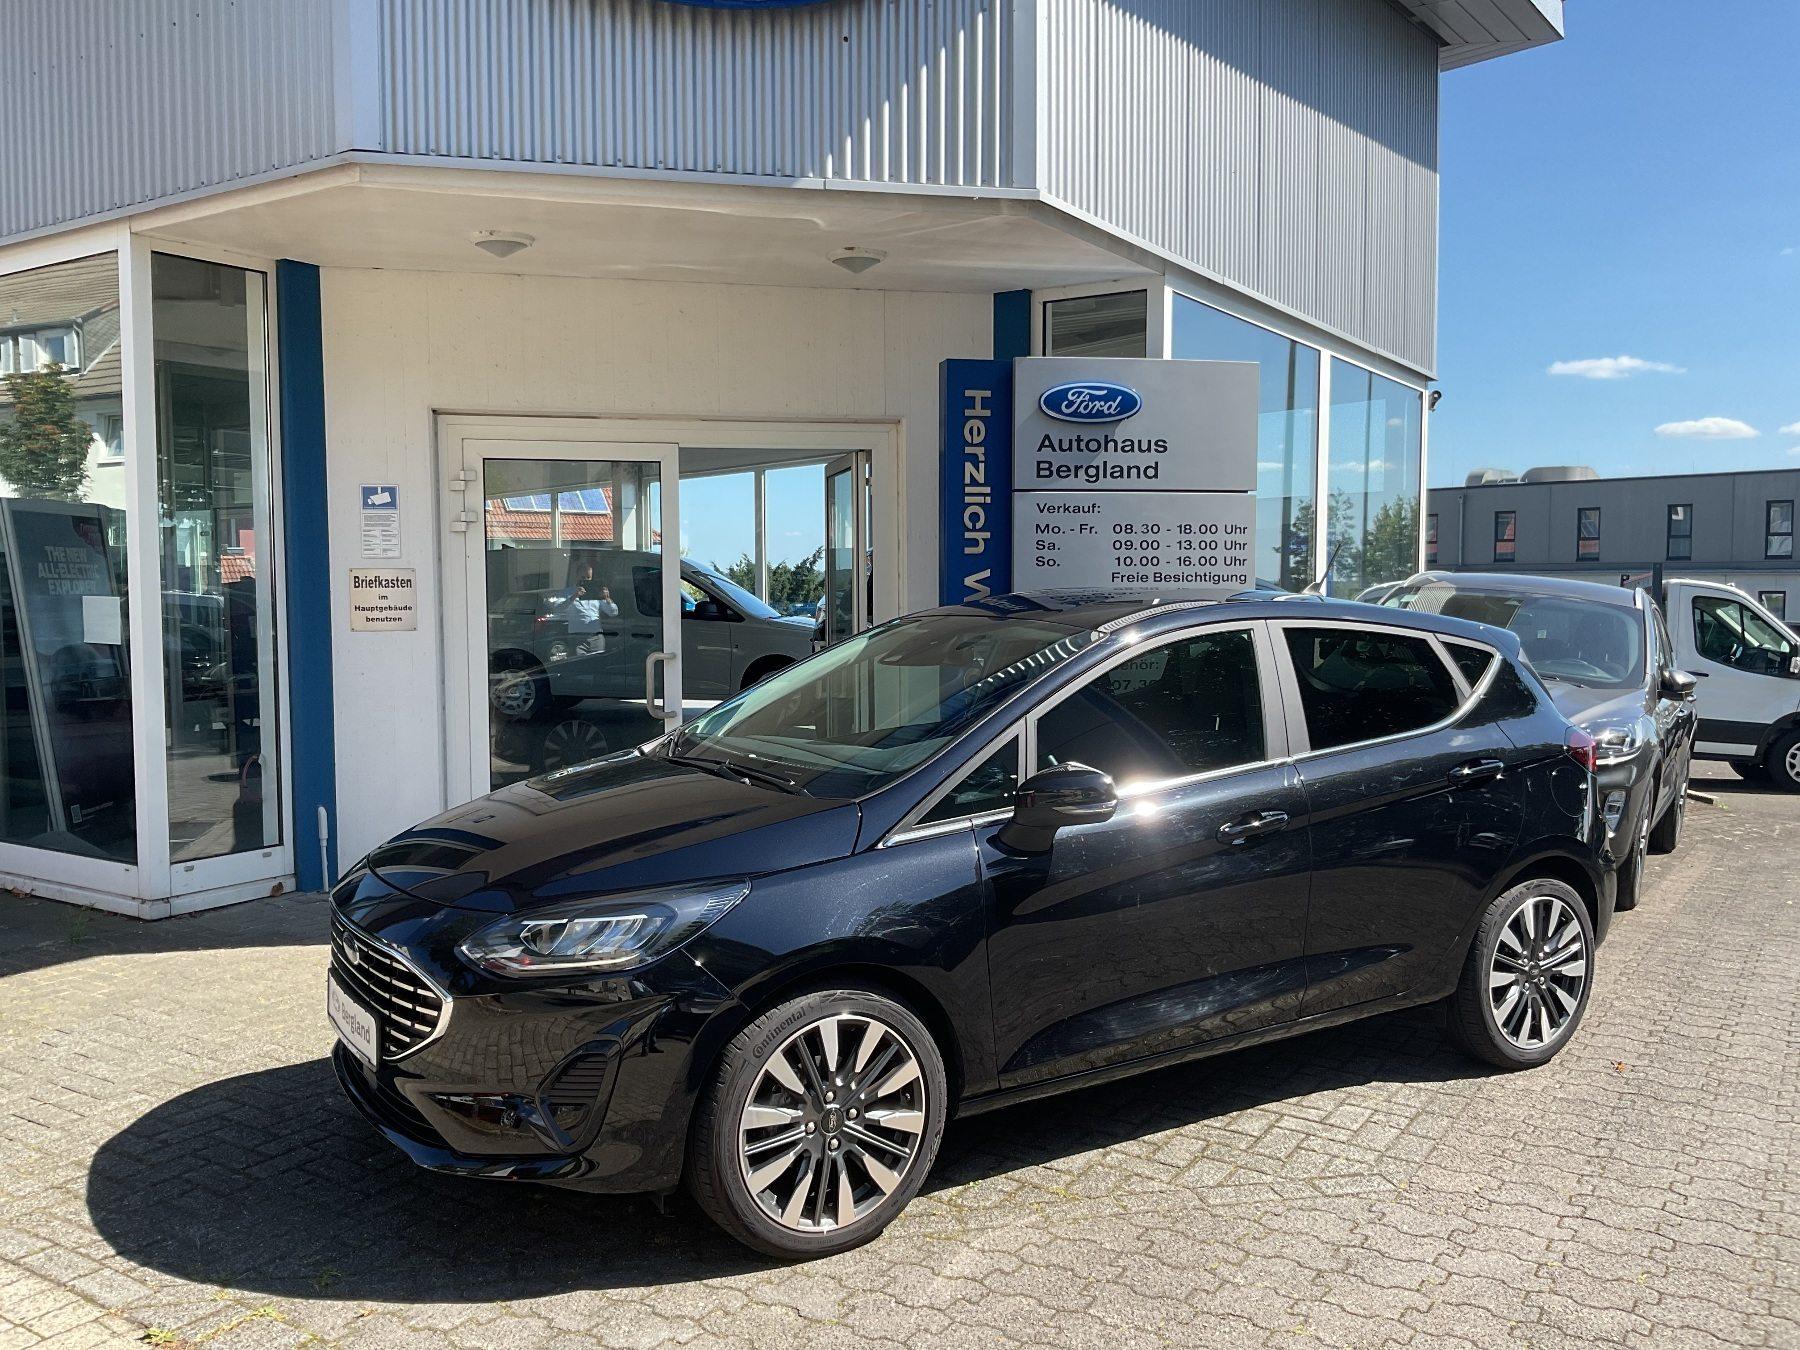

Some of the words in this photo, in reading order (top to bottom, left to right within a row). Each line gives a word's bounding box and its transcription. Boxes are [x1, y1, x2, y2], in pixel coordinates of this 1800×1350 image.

[1061, 387, 1121, 415] Ford
[1036, 433, 1168, 453] Autohaus
[963, 389, 991, 554] Herzlich
[1036, 460, 1159, 483] Bergland
[1036, 502, 1101, 514] Verkauf:
[1035, 523, 1066, 535] Mo.
[1078, 523, 1098, 535] Fr.
[1112, 523, 1161, 535] 08.30
[1176, 524, 1218, 535] 18.00
[1224, 524, 1248, 535] Uhr
[1035, 540, 1061, 551] Sa.
[1112, 540, 1160, 551] 09.00
[1176, 540, 1218, 551] 13.00
[1224, 540, 1248, 551] Uhr
[1035, 556, 1061, 567] So.
[1115, 556, 1160, 567] 10.00
[1176, 556, 1218, 567] 16.00
[1224, 556, 1248, 567] Uhr
[353, 575, 413, 589] Briefkasten
[1111, 572, 1149, 583] Freie
[1153, 572, 1247, 585] Besichtigung
[354, 605, 413, 613] Hauptgebäude
[365, 615, 403, 623] benutzen
[341, 1001, 371, 1045] Bergland
[752, 1006, 807, 1059] Continental
